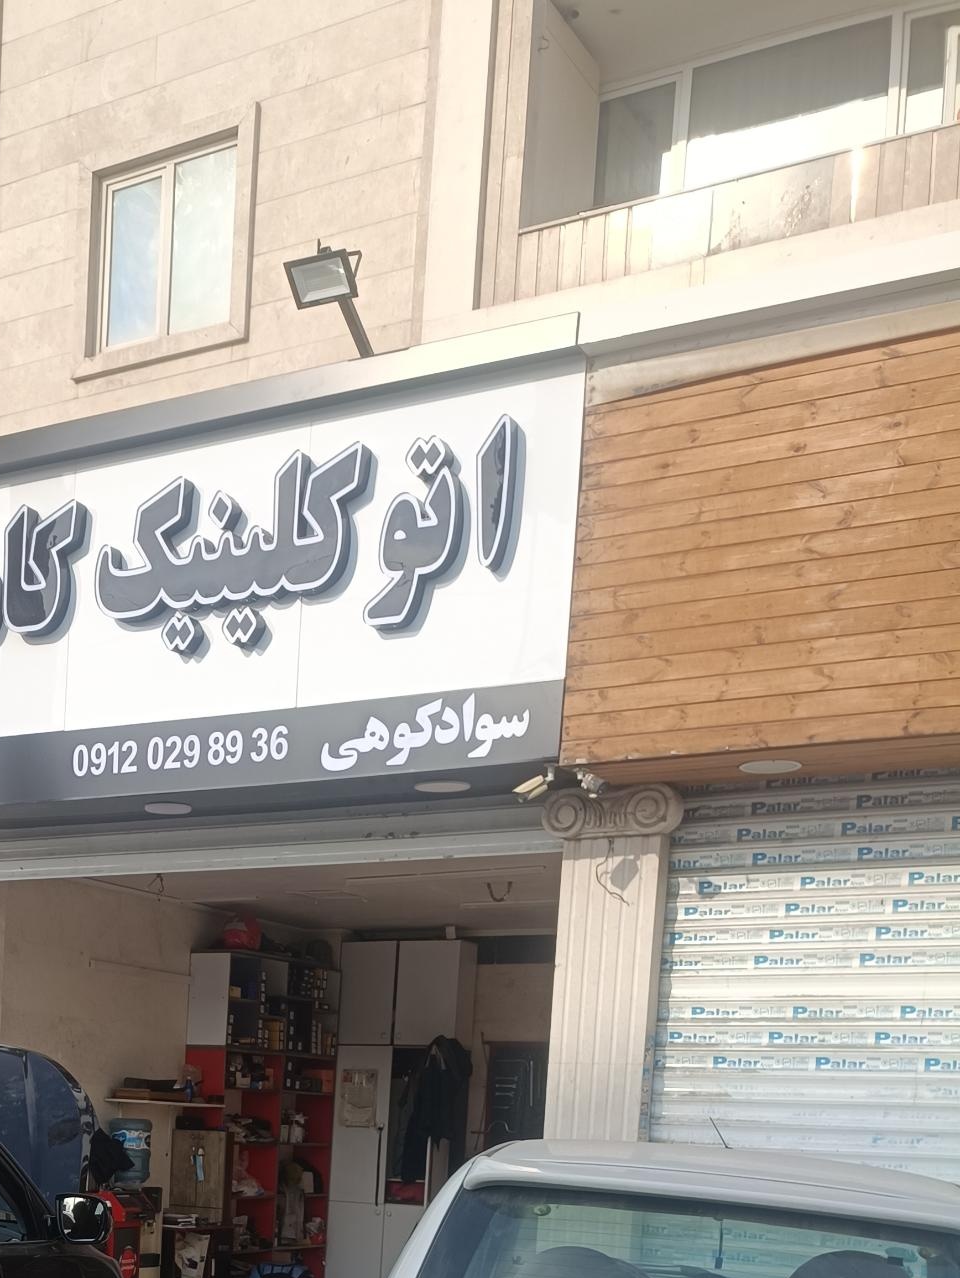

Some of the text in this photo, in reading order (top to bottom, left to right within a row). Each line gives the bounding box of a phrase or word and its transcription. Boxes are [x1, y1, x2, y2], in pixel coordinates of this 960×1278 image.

[96, 440, 378, 655] کلینیک
[364, 411, 527, 629] اتو
[72, 725, 290, 777] 0912 029 89 36
[320, 691, 530, 771] سوادکوهی
